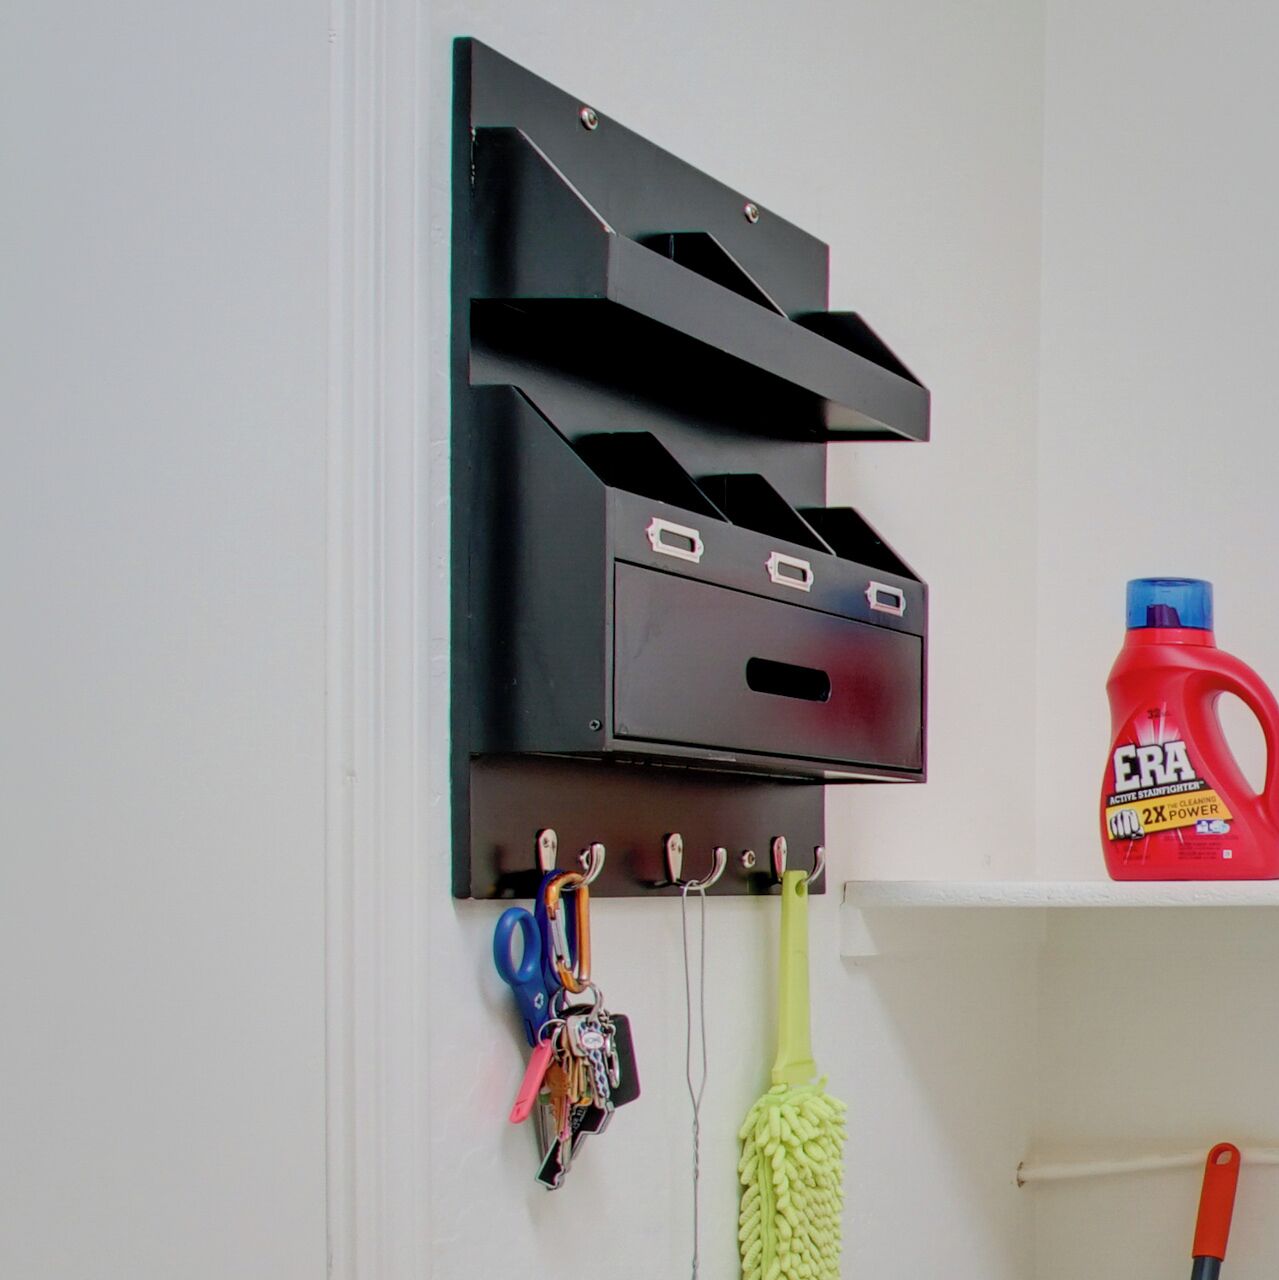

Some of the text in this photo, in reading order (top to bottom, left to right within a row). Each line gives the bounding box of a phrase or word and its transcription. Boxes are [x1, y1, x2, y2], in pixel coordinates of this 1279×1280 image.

[1113, 741, 1196, 793] ERA
[1109, 782, 1201, 805] ACTIVE STAINFIGHTER
[1142, 805, 1167, 825] 2X
[1179, 796, 1216, 807] CLEANING
[1169, 804, 1218, 820] POWER
